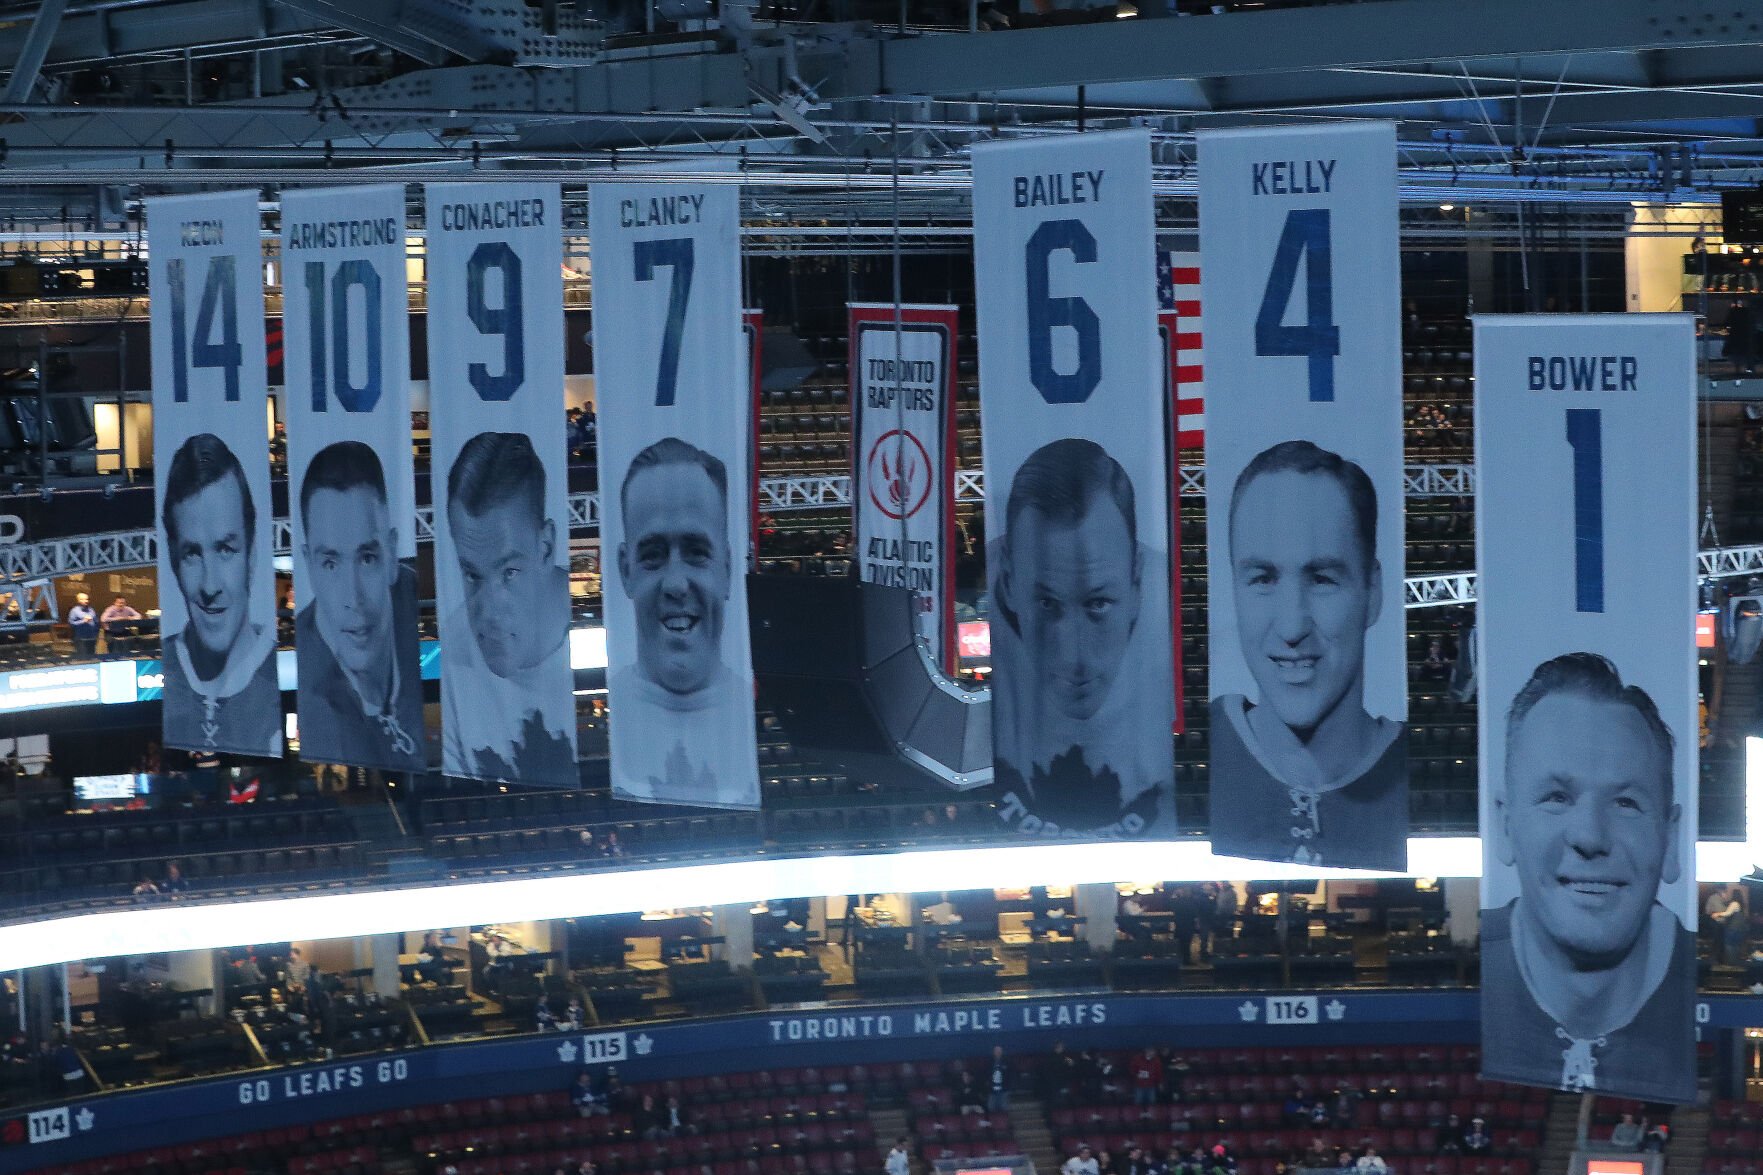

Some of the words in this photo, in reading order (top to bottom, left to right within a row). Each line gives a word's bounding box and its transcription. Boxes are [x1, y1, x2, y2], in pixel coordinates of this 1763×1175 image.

[1013, 170, 1104, 208] BAILEY
[1253, 160, 1336, 195] KELLY
[442, 198, 544, 231] CONACHER
[621, 194, 704, 228] CLANCY
[180, 219, 224, 247] KEON
[289, 217, 396, 249] ARMSTRONG
[467, 241, 525, 402] 9
[633, 238, 694, 406] 7
[1025, 218, 1102, 404] 6
[1255, 208, 1340, 402] 4
[167, 254, 243, 403] 14
[305, 259, 382, 413] 10
[868, 358, 935, 383] TORONTO
[1528, 356, 1638, 391] BOWER
[868, 385, 935, 411] RAPTORS
[1566, 408, 1604, 613] 1
[770, 1015, 893, 1041] TORONTO
[914, 1008, 1002, 1034] MAPLE
[1023, 1003, 1106, 1028] LEAFS
[1274, 1001, 1309, 1019] 116
[588, 1038, 621, 1058] 115
[239, 1080, 270, 1104] GO
[285, 1065, 363, 1097] LEAFS
[377, 1059, 408, 1083] GO
[32, 1113, 65, 1137] 114
